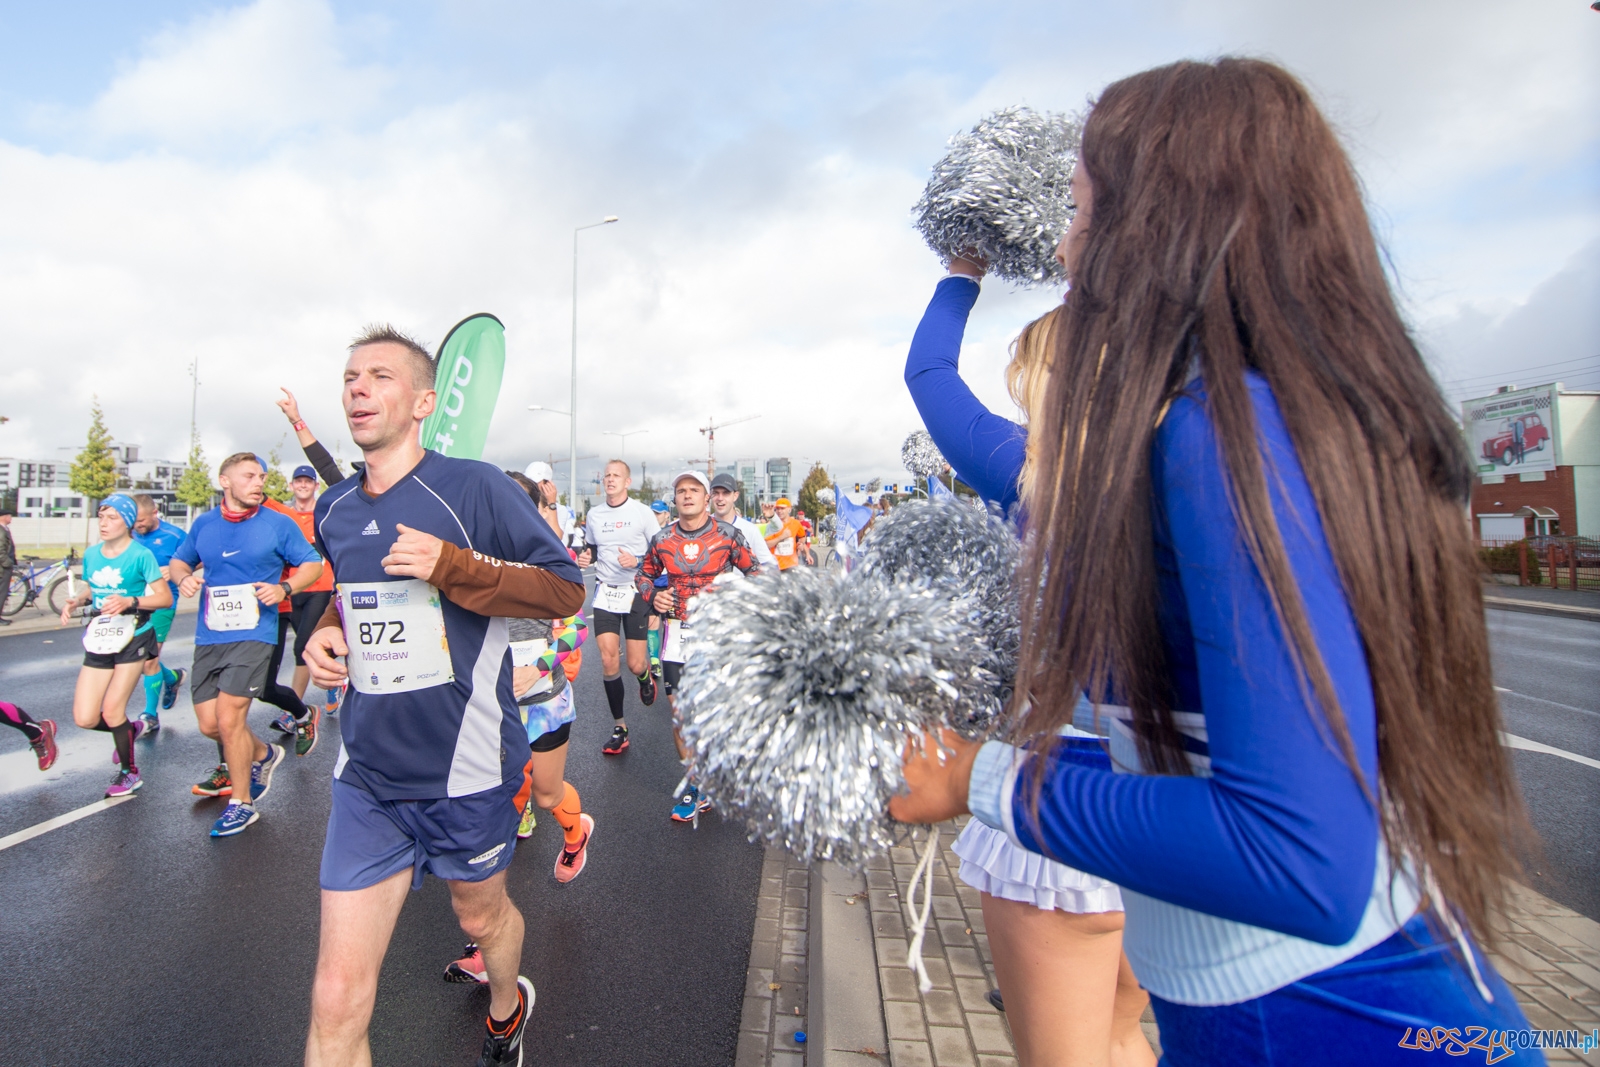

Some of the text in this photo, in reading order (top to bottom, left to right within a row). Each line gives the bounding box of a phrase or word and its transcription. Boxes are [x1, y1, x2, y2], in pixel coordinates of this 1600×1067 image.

[605, 591, 626, 599] 4417
[217, 600, 243, 611] 494
[352, 596, 376, 605] 17.PKO
[94, 627, 124, 637] 5056
[359, 620, 406, 645] 872
[362, 651, 409, 661] Mirosław
